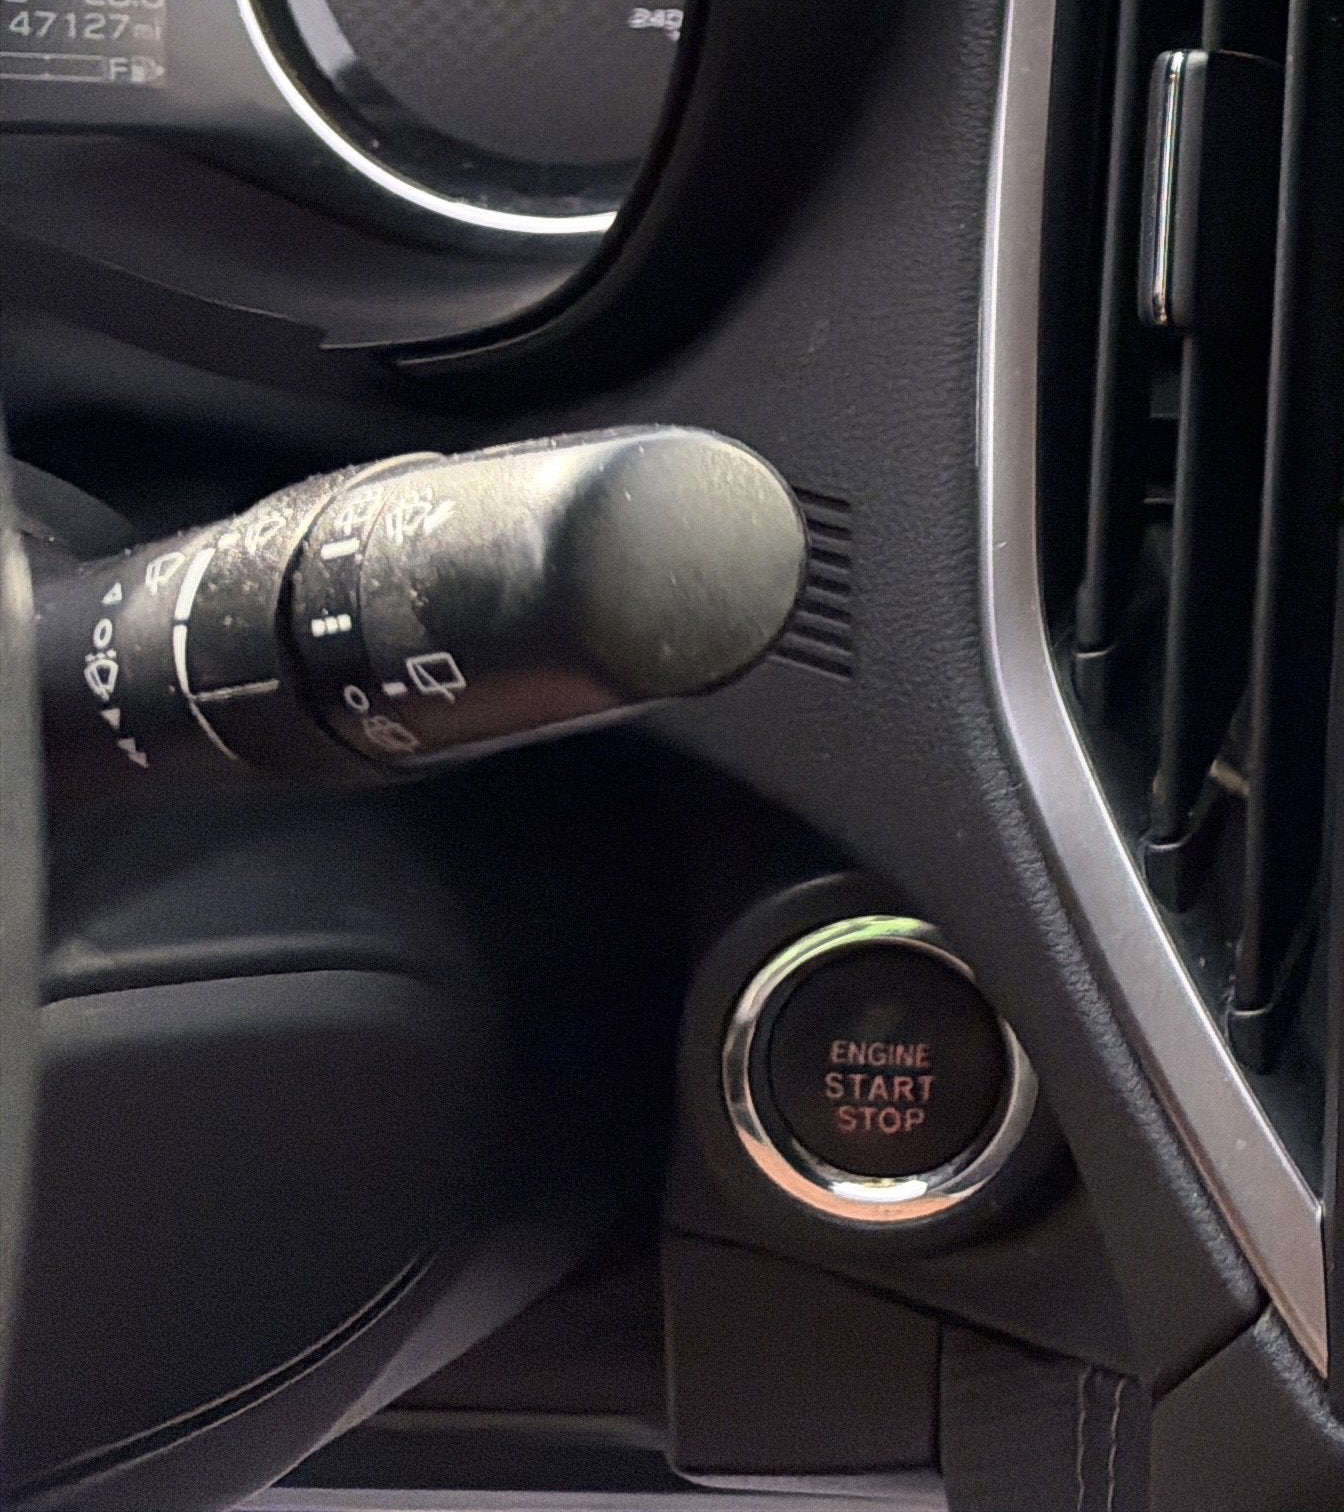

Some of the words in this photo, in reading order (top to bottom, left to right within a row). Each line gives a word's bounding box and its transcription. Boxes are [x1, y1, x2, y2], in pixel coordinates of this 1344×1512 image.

[8, 10, 131, 40] 47127
[108, 56, 129, 81] F
[830, 1039, 931, 1069] ENGINE
[824, 1071, 937, 1103] START
[837, 1105, 926, 1135] STOP
